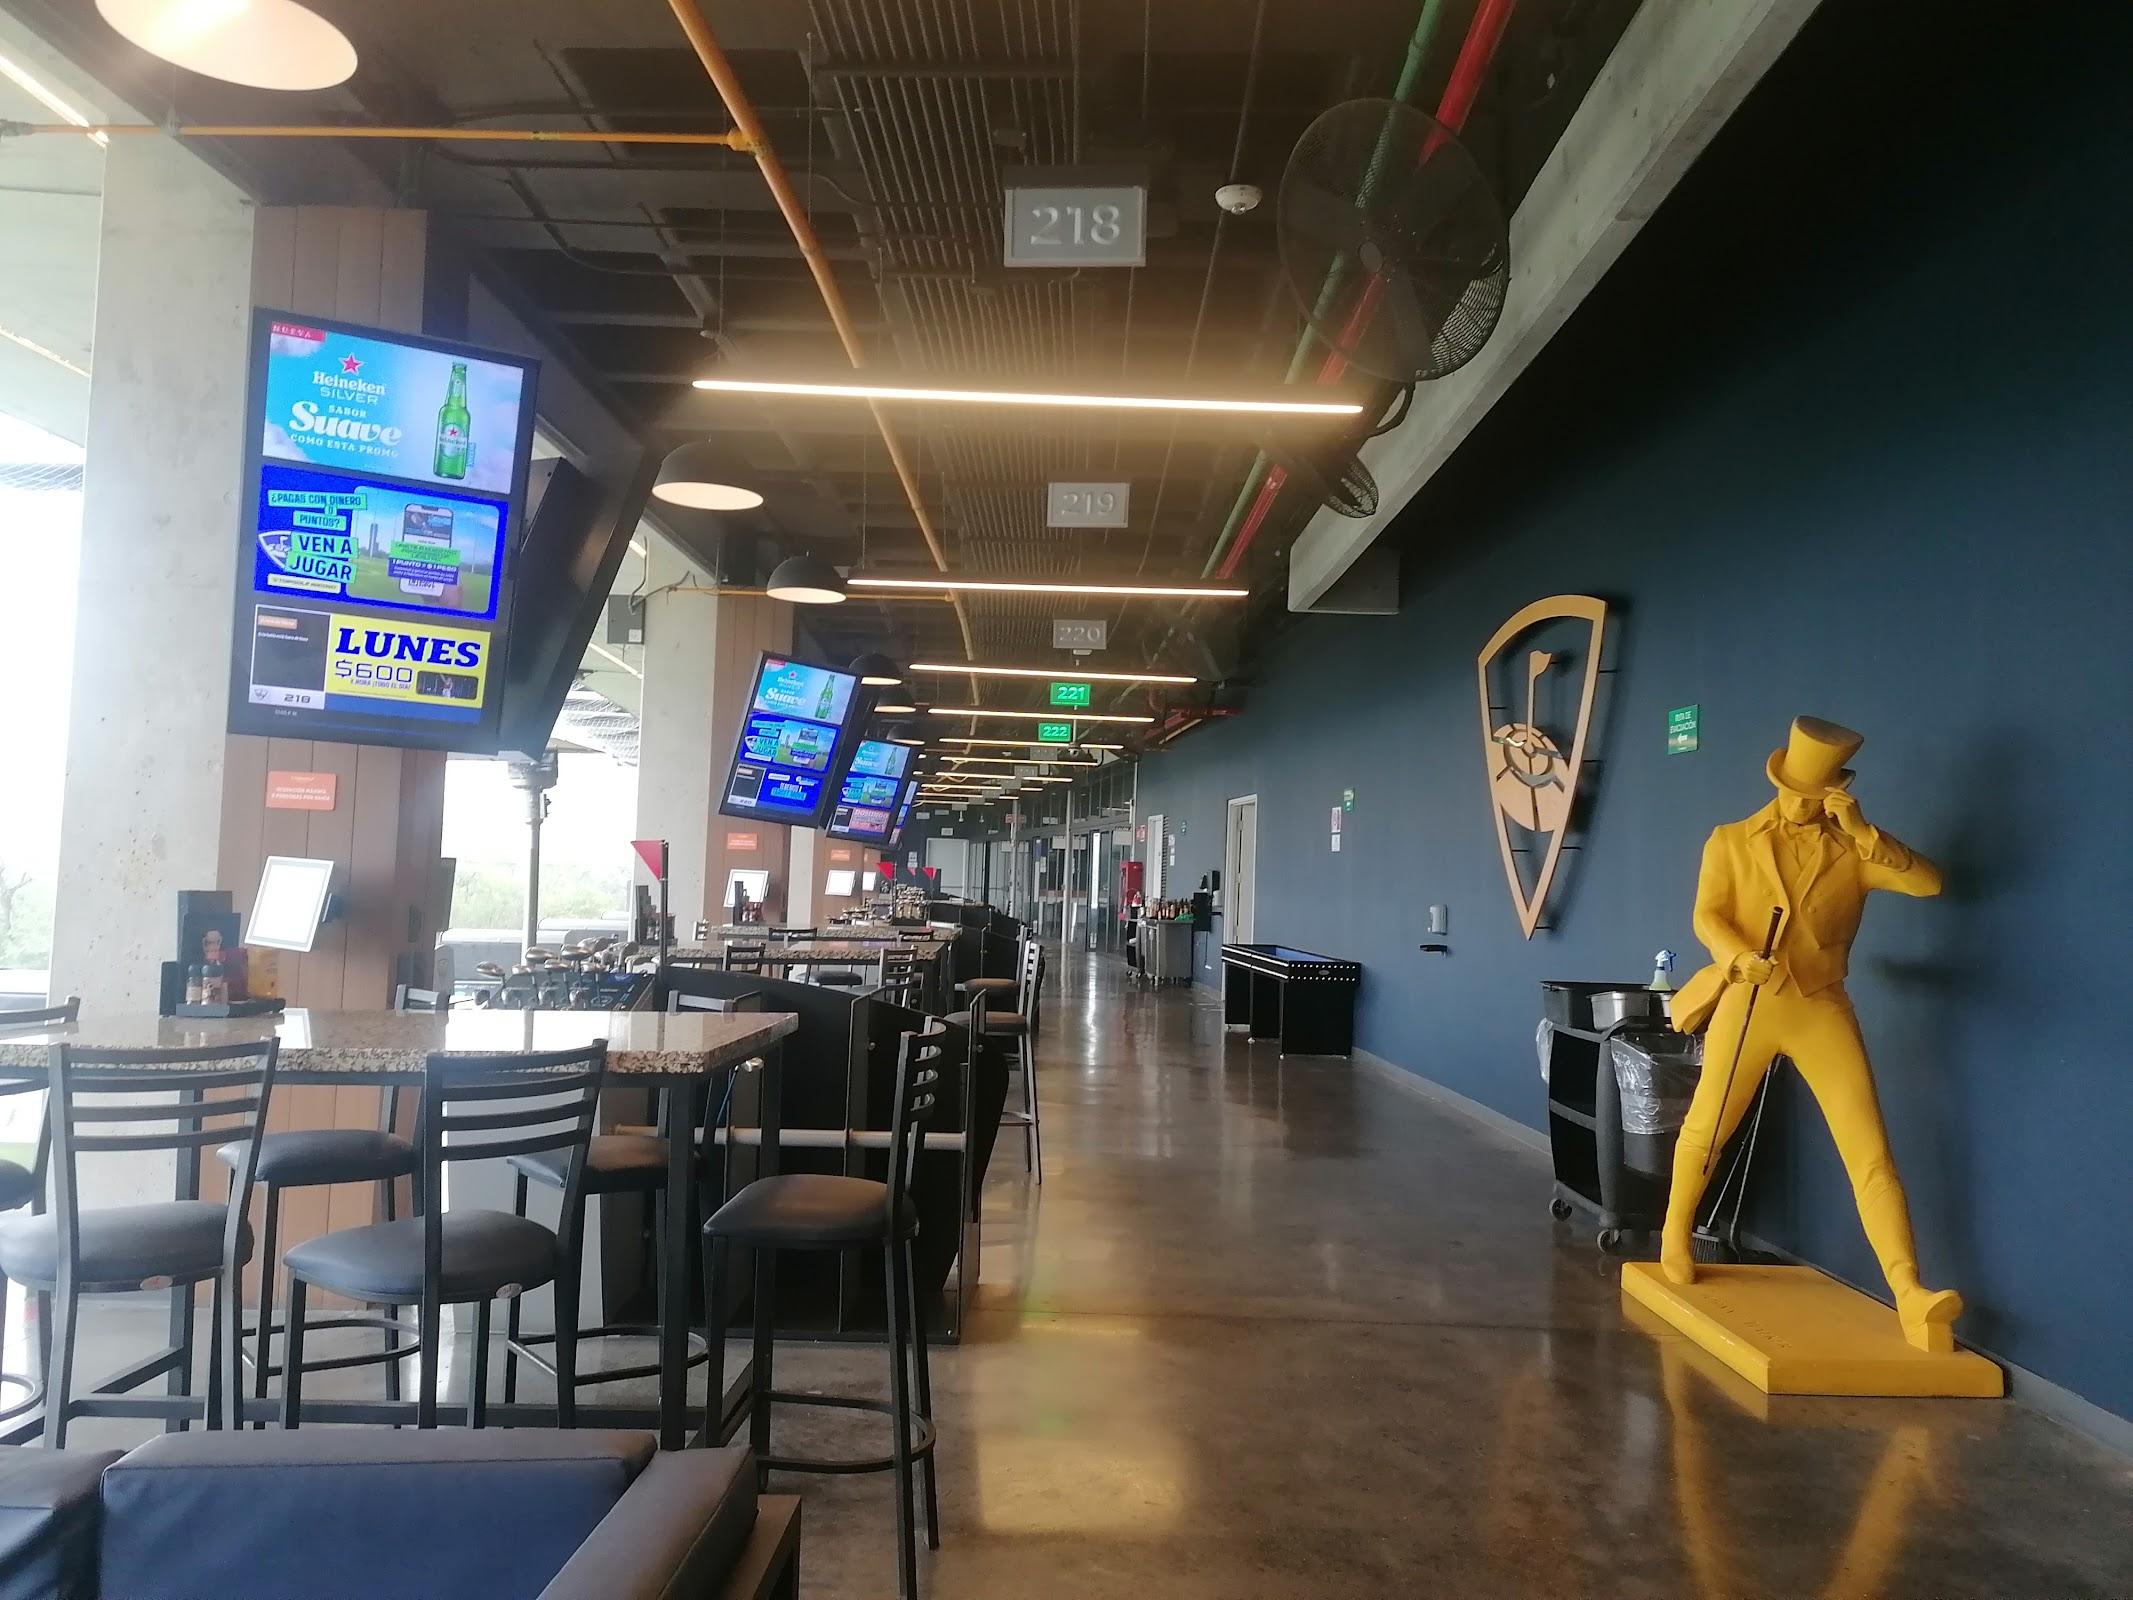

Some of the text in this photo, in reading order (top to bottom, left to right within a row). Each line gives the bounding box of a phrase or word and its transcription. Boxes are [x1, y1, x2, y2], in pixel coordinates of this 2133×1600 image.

[1029, 204, 1121, 246] 218
[272, 324, 312, 339] NUEVA
[312, 371, 385, 396] Heineken
[320, 386, 379, 406] SILVER
[328, 404, 367, 419] SABOR
[288, 400, 402, 446] Suave
[290, 433, 399, 458] COMO ESTA PROMO
[308, 493, 327, 505] CON
[329, 495, 361, 506] DINERO
[1061, 492, 1114, 517] 219
[299, 513, 340, 528] PUNTOS?
[298, 534, 352, 554] VEN A
[290, 556, 352, 580] JUGAR
[1060, 626, 1100, 642] 220
[335, 627, 481, 667] LUNES
[335, 659, 413, 683] $600
[284, 693, 311, 704] 218
[1057, 686, 1085, 700] 221
[1042, 726, 1068, 737] 222
